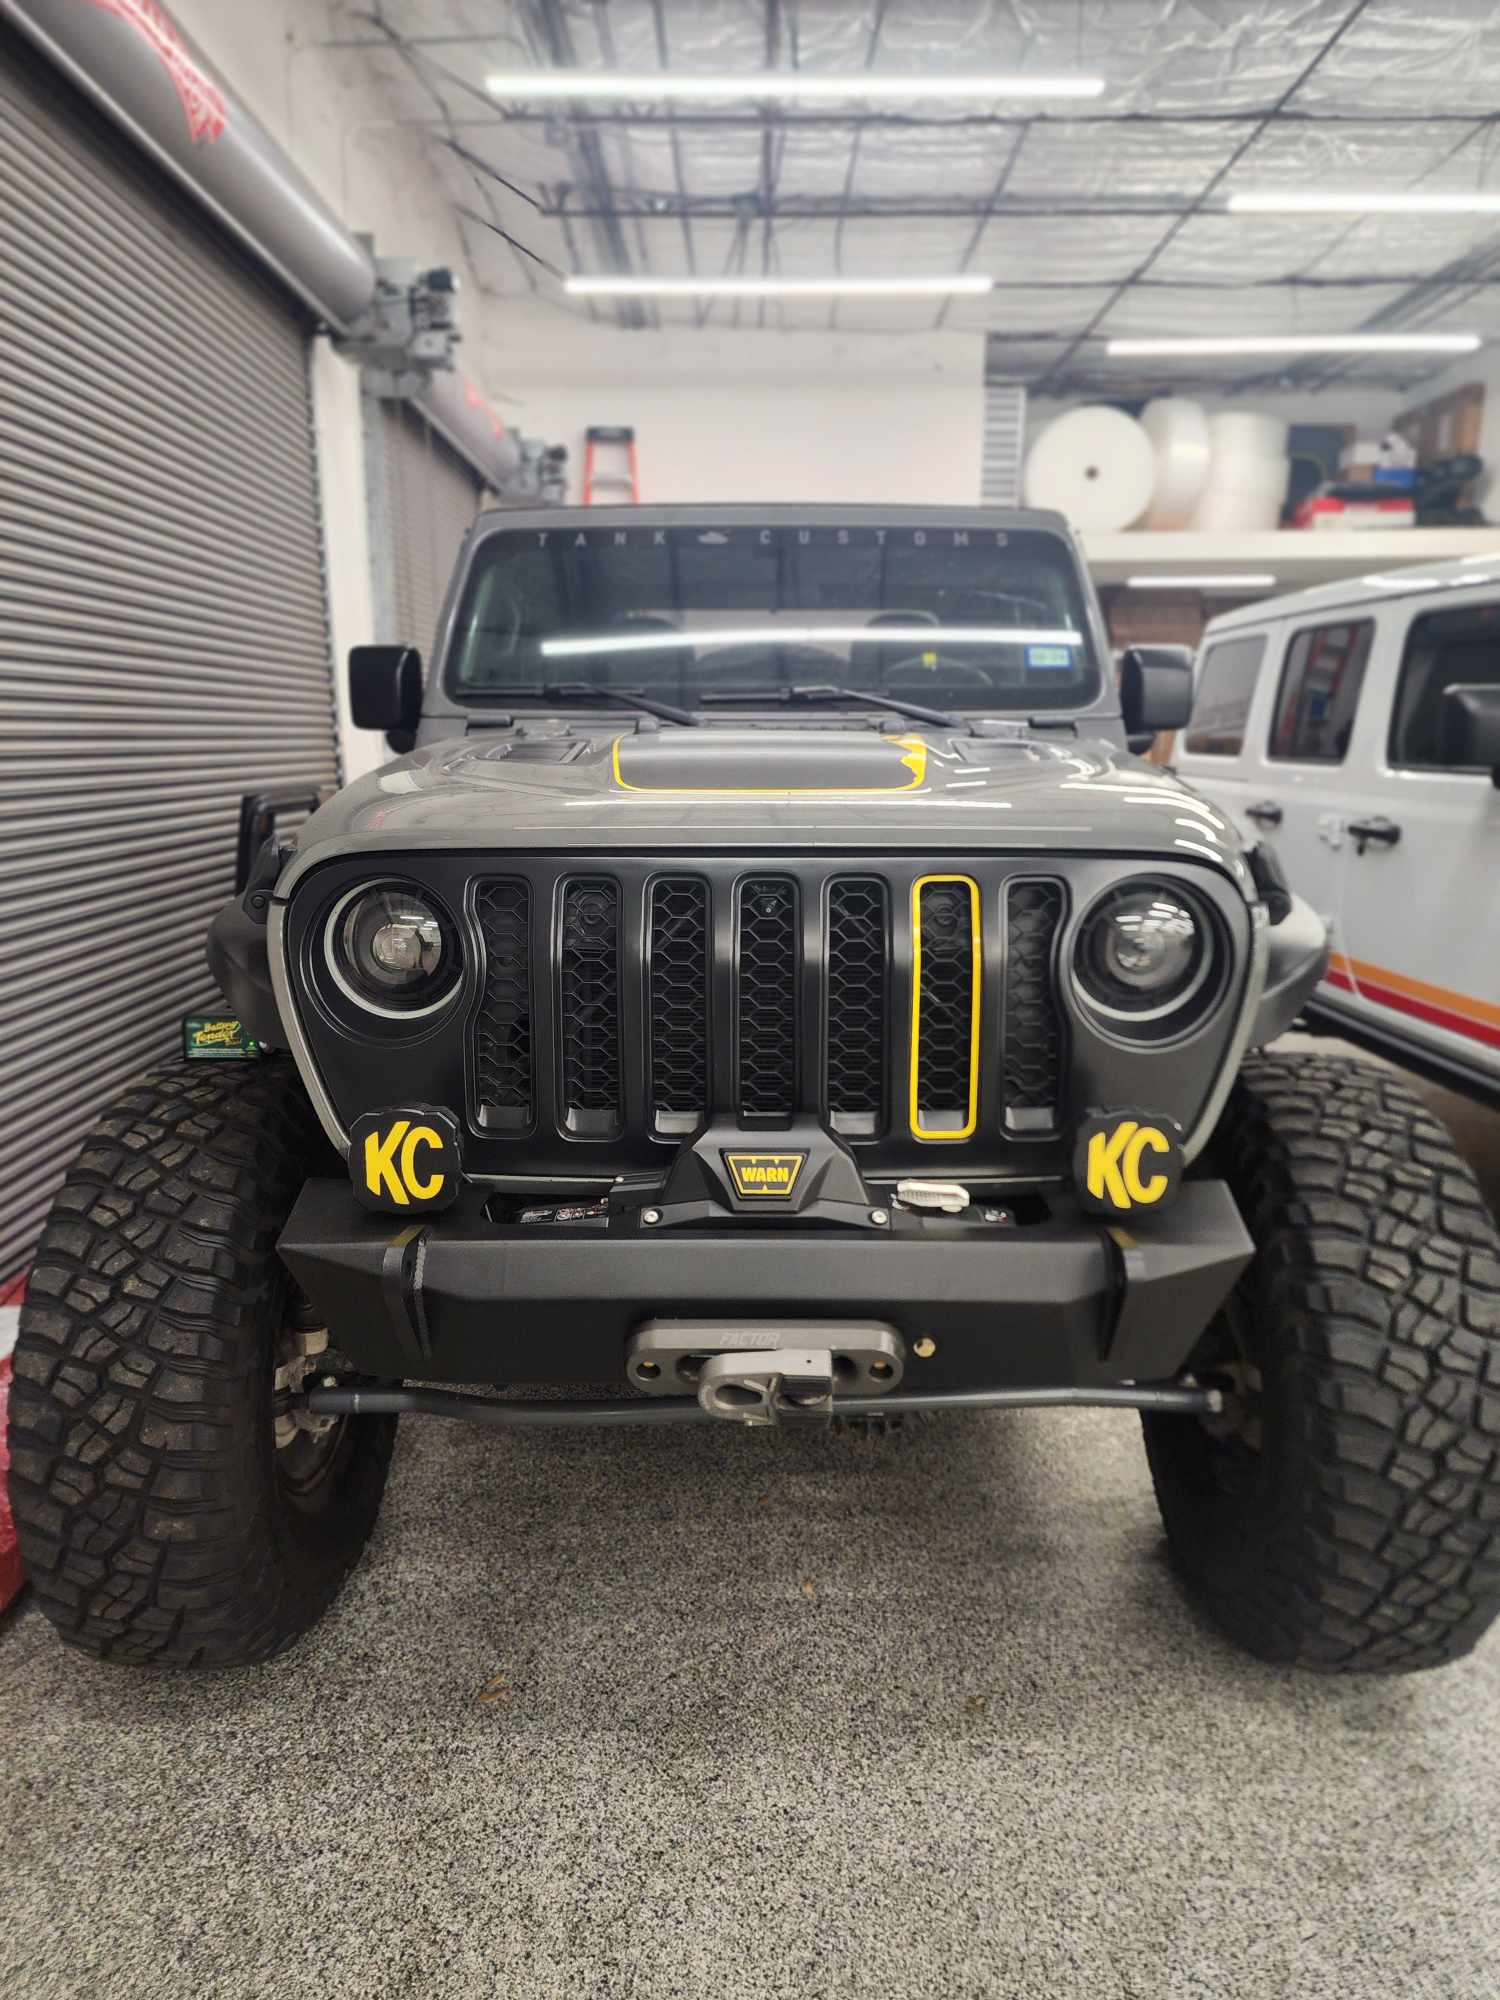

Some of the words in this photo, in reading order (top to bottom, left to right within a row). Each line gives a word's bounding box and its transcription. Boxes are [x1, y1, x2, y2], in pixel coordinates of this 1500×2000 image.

[537, 531, 666, 547] TANK
[758, 529, 1009, 548] CUSTOMS
[192, 1030, 234, 1046] Tender
[365, 1121, 445, 1205] KC
[1087, 1121, 1170, 1209] KC
[741, 1167, 789, 1182] WARN
